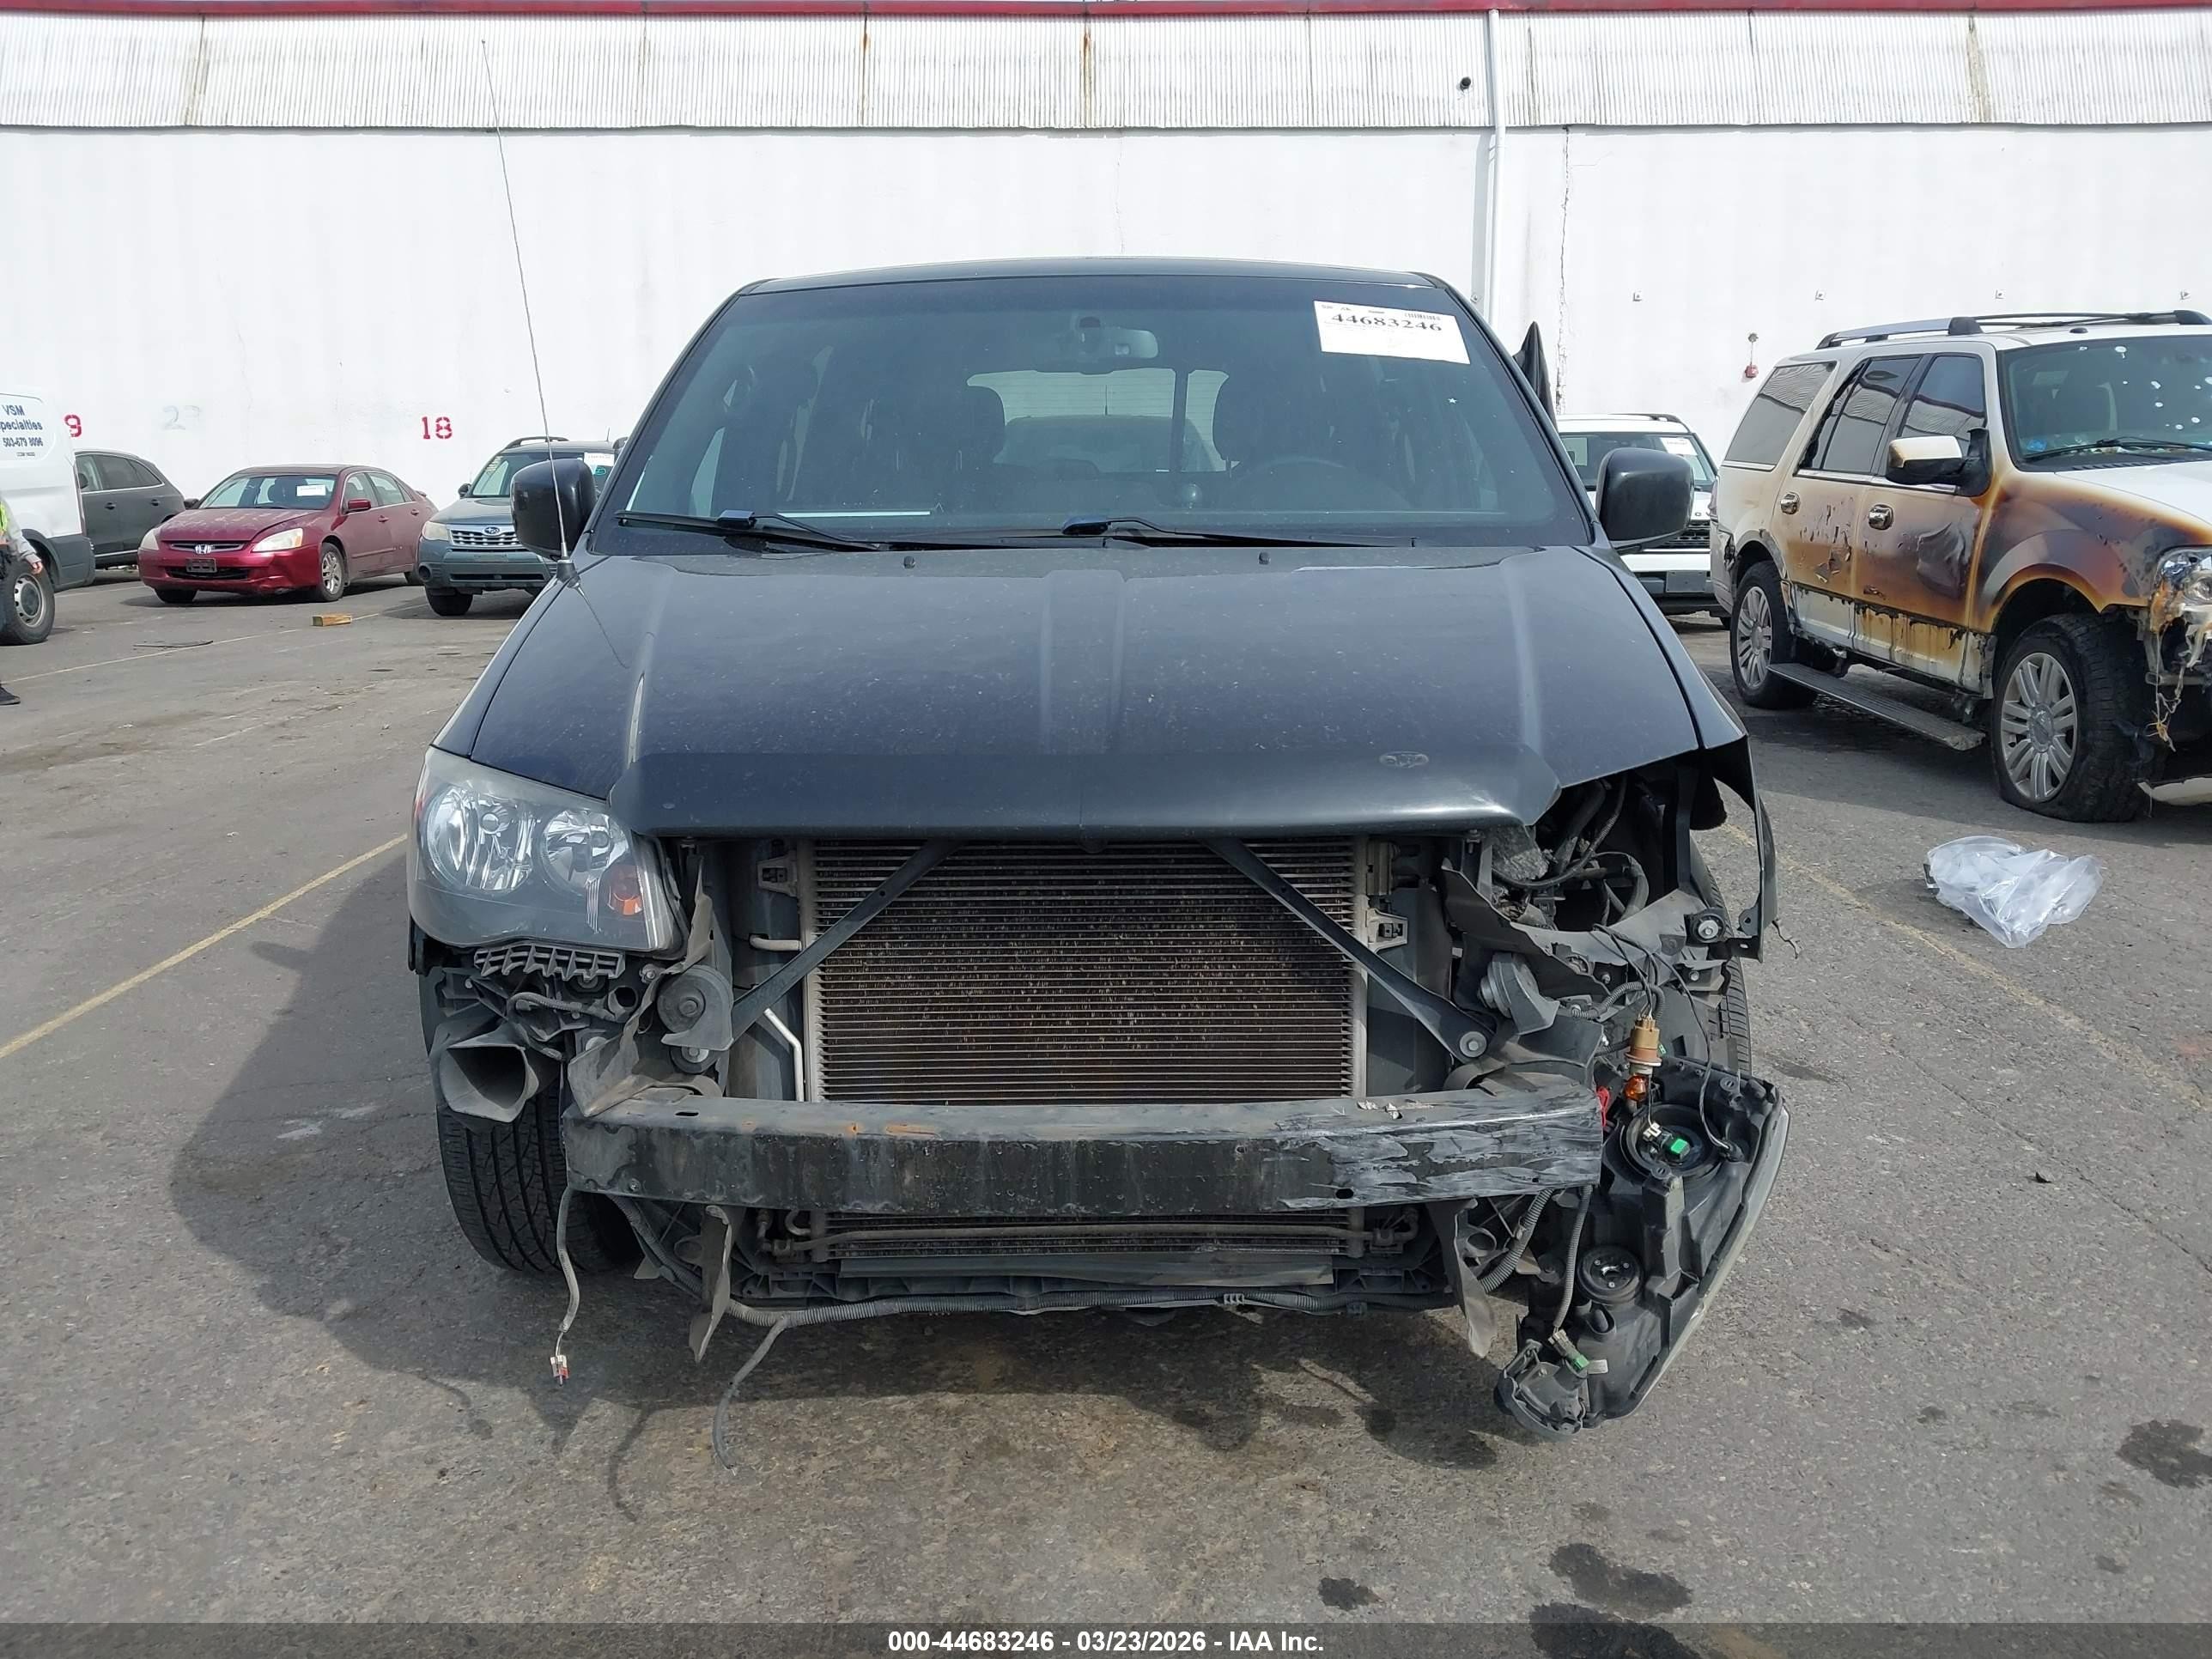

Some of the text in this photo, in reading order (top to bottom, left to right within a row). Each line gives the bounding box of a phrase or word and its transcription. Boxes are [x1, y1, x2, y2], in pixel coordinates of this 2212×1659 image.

[1332, 313, 1443, 331] 44683246
[2, 404, 25, 416] VSM
[0, 418, 43, 433] pecialties
[422, 416, 453, 440] 18
